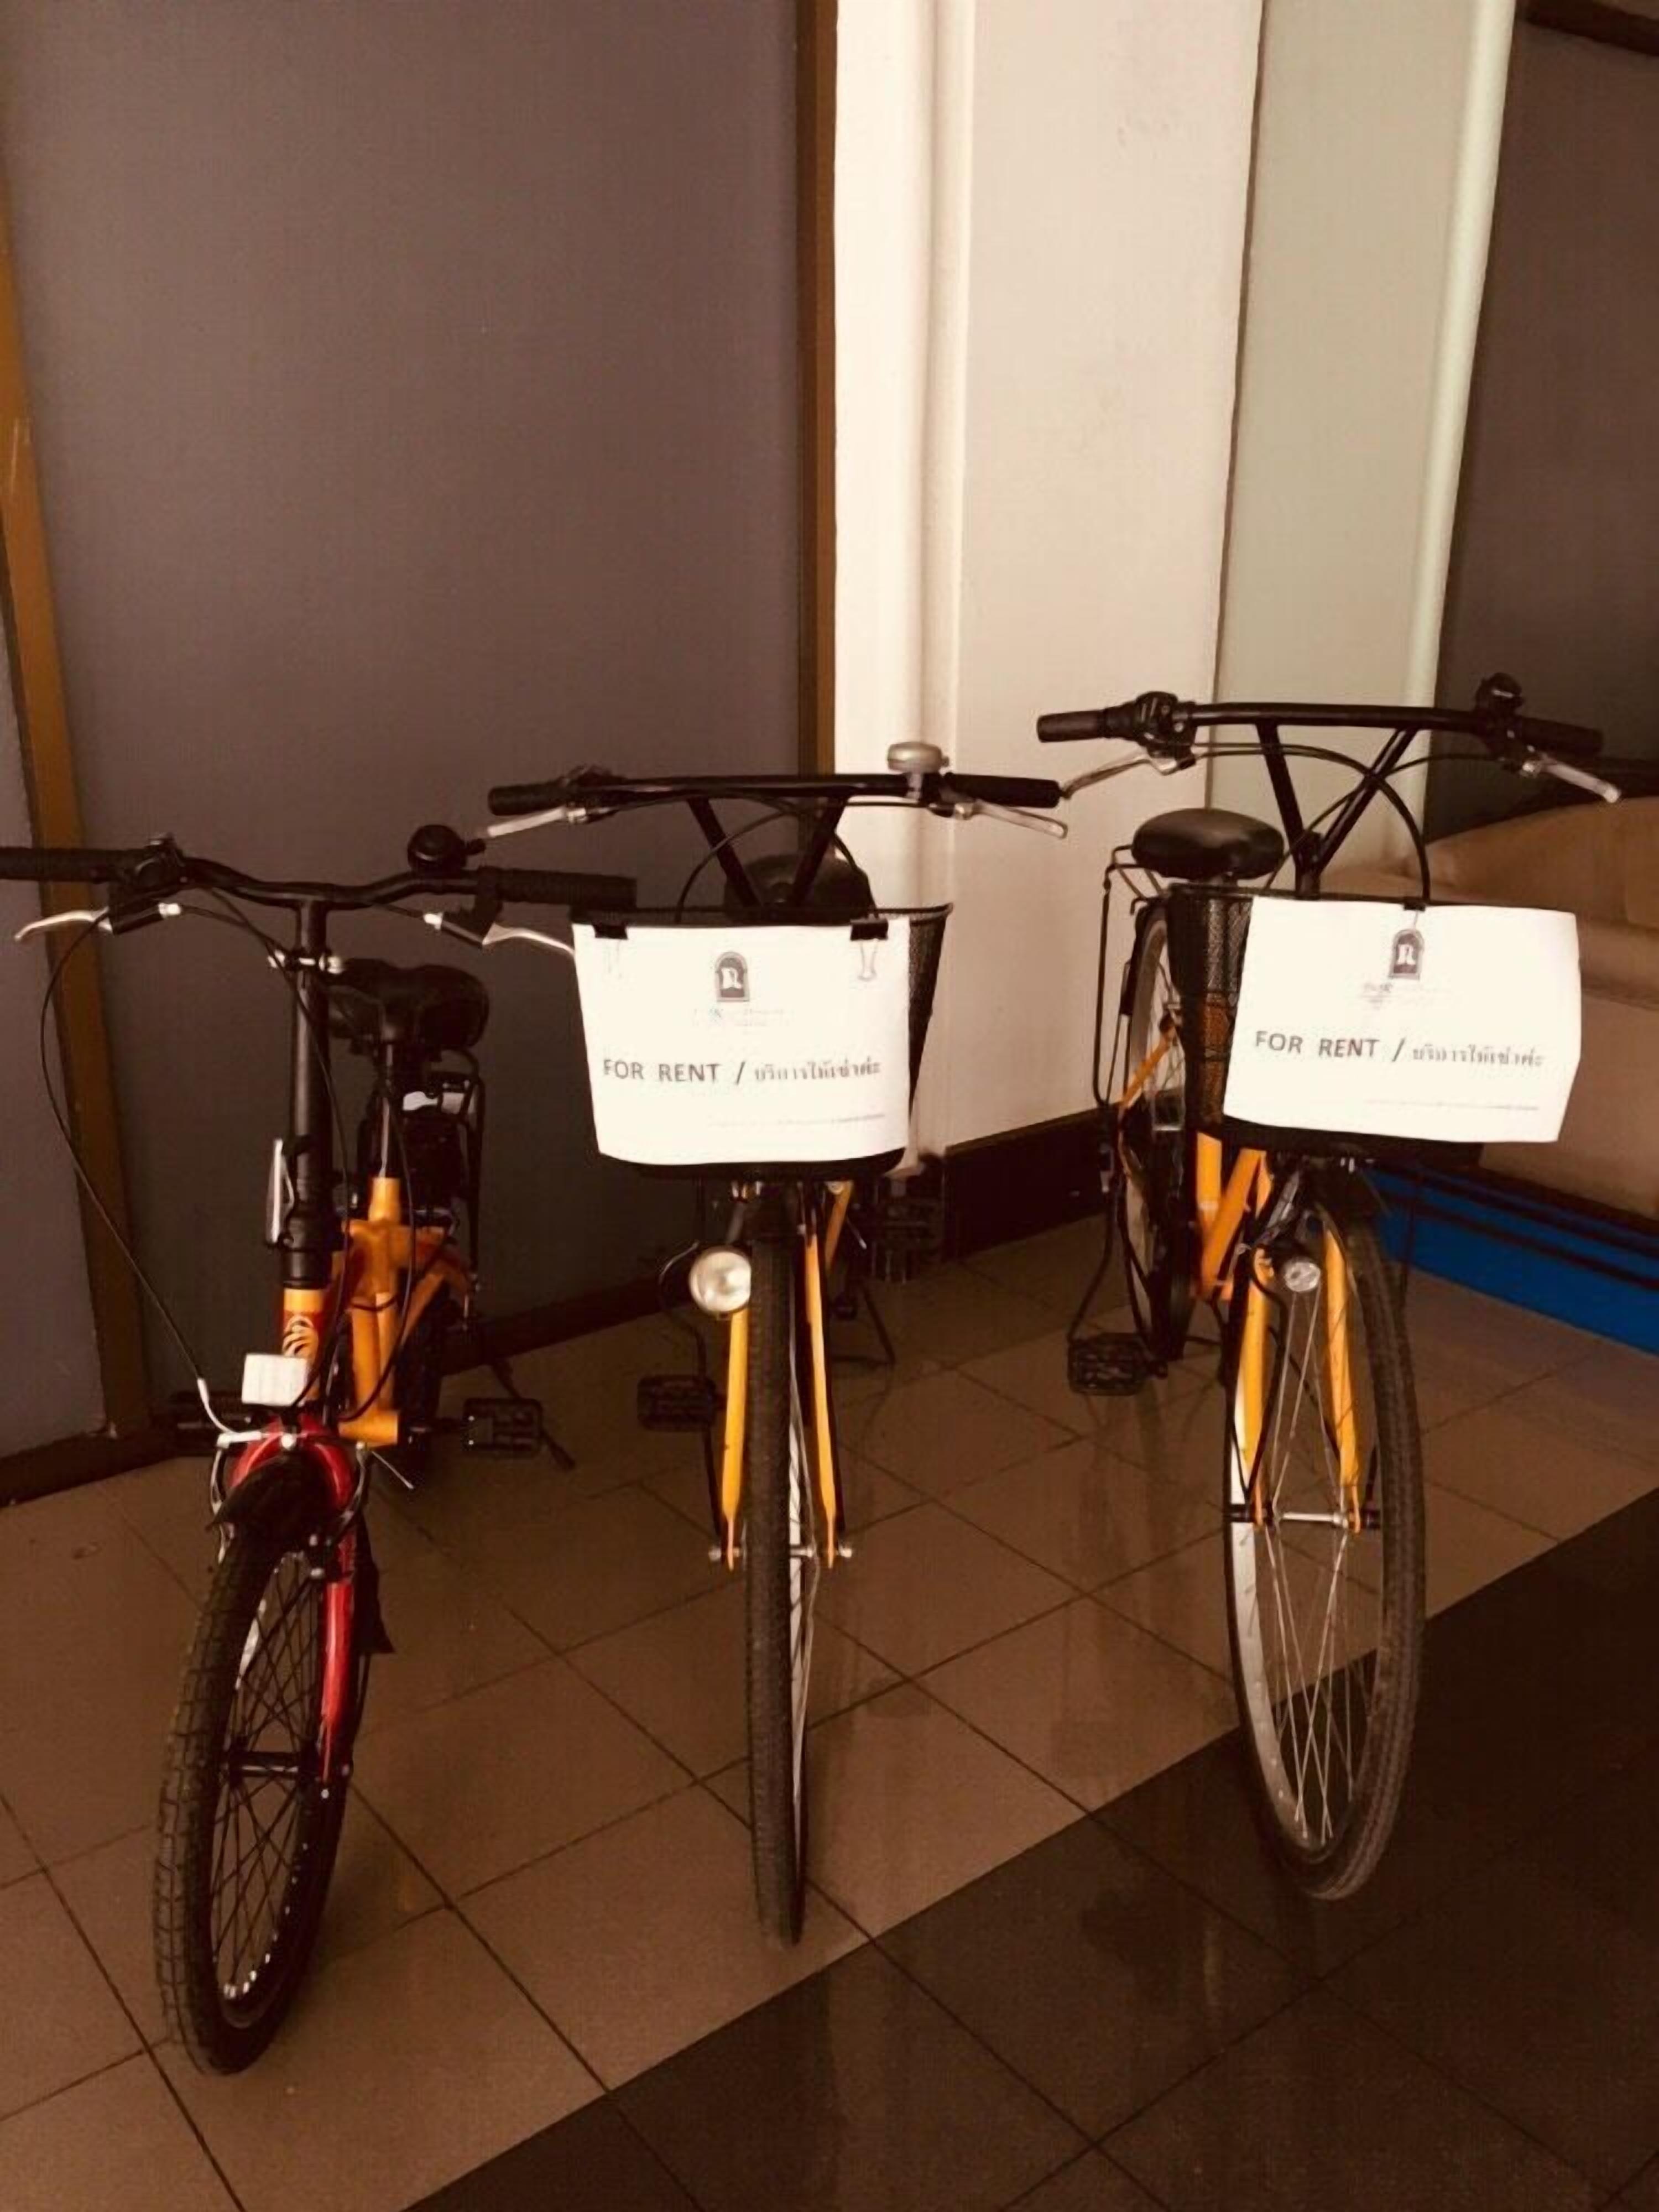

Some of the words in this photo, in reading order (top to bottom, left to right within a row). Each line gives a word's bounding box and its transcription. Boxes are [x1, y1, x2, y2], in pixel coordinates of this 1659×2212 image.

[1255, 1030, 1303, 1054] FOR
[1318, 1038, 1380, 1058] RENT
[1391, 1038, 1405, 1062] /
[603, 1059, 644, 1081] FOR
[658, 1063, 720, 1082] RENT
[735, 1061, 746, 1086] /
